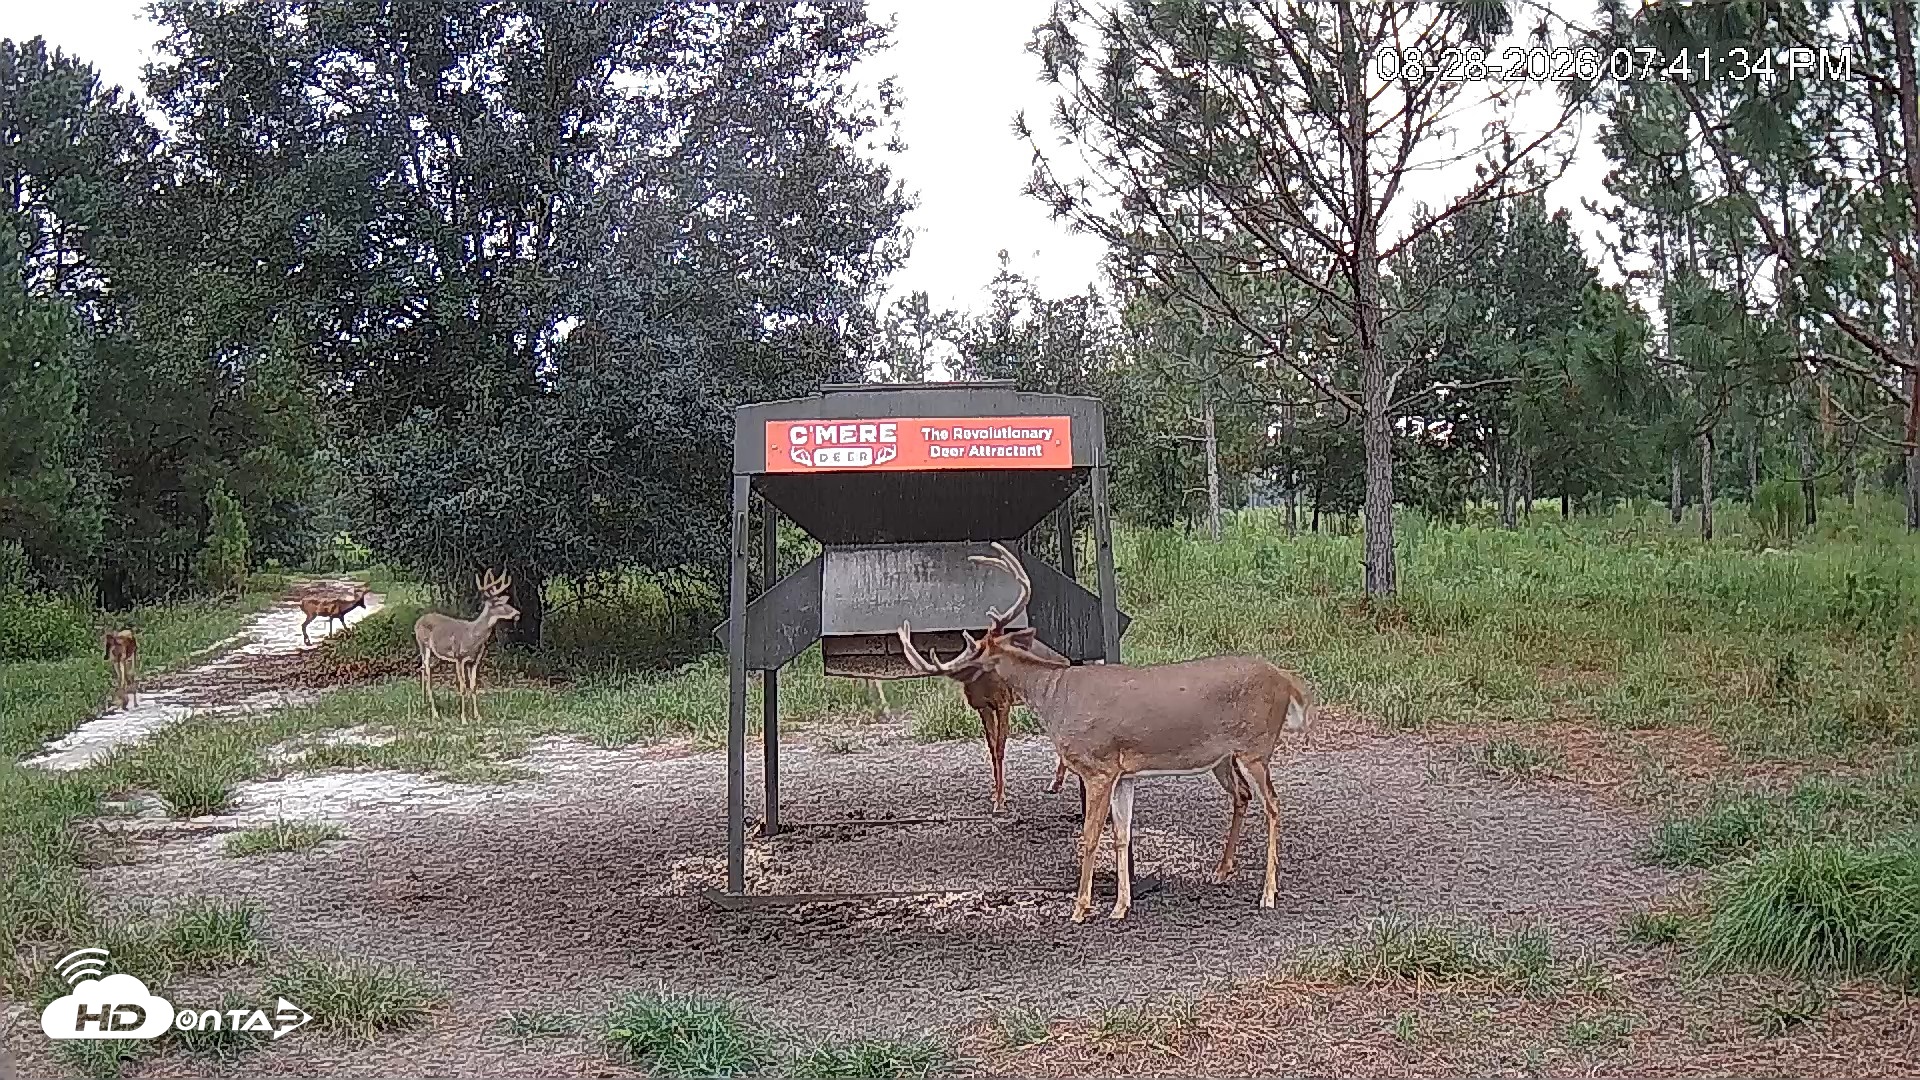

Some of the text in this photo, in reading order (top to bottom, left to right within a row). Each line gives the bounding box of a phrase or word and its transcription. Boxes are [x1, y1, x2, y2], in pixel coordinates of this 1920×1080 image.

[789, 423, 897, 445] C'MERE
[920, 426, 1053, 441] The Revolutionary
[819, 451, 868, 462] DEER
[930, 444, 1043, 458] Deer Attractant
